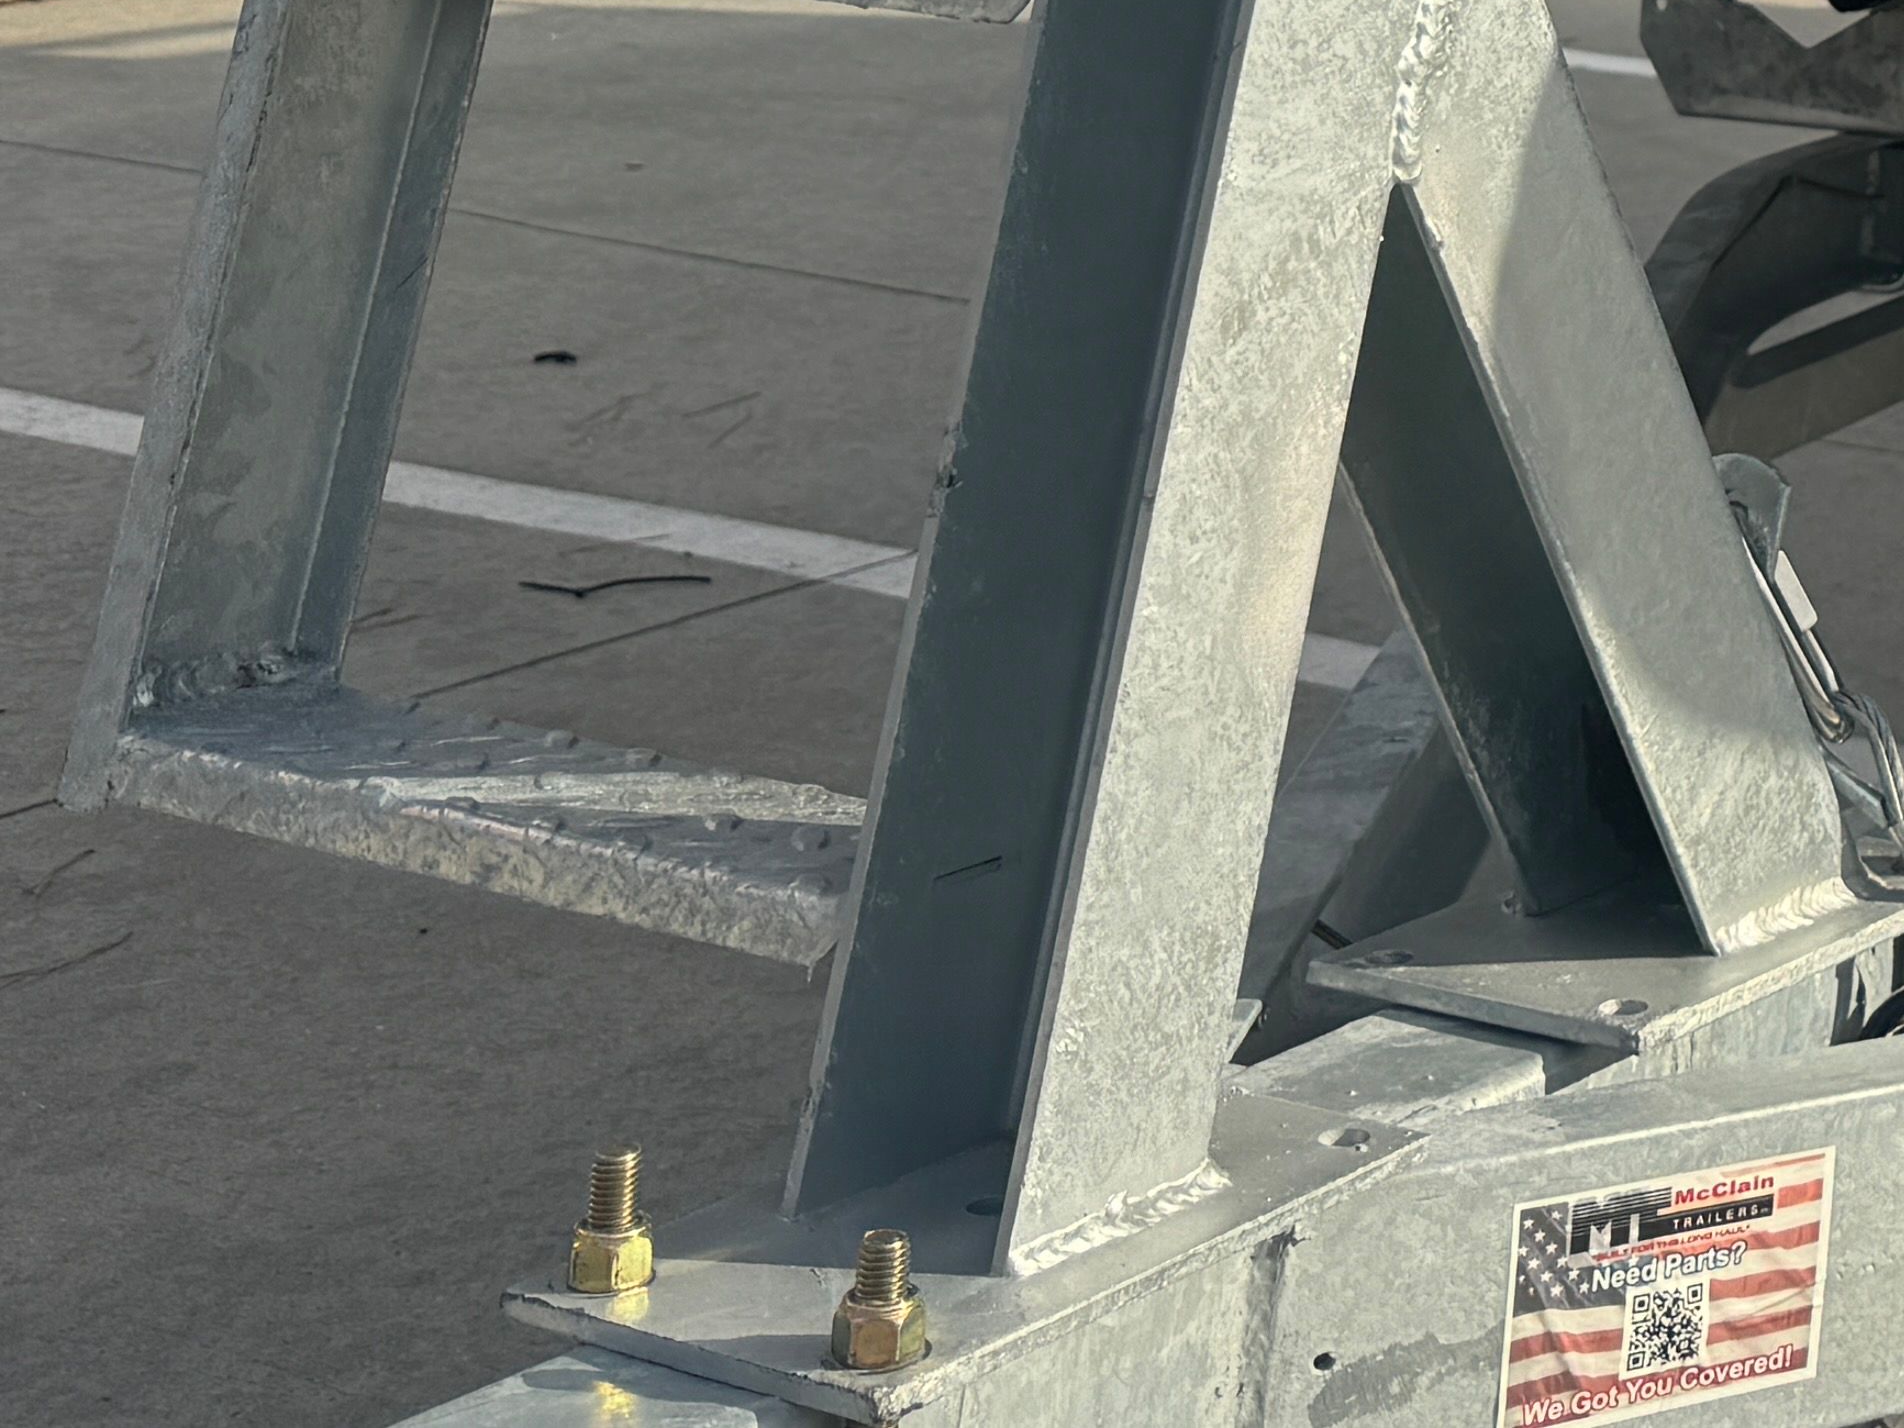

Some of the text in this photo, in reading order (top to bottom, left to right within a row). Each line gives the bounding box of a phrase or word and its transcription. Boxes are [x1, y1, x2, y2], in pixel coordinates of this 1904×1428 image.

[1674, 1176, 1774, 1205] McClain
[1673, 1204, 1758, 1230] TRAILERS
[1591, 1239, 1748, 1292] Need Parts?
[1522, 1344, 1795, 1427] We Got You Covered!
